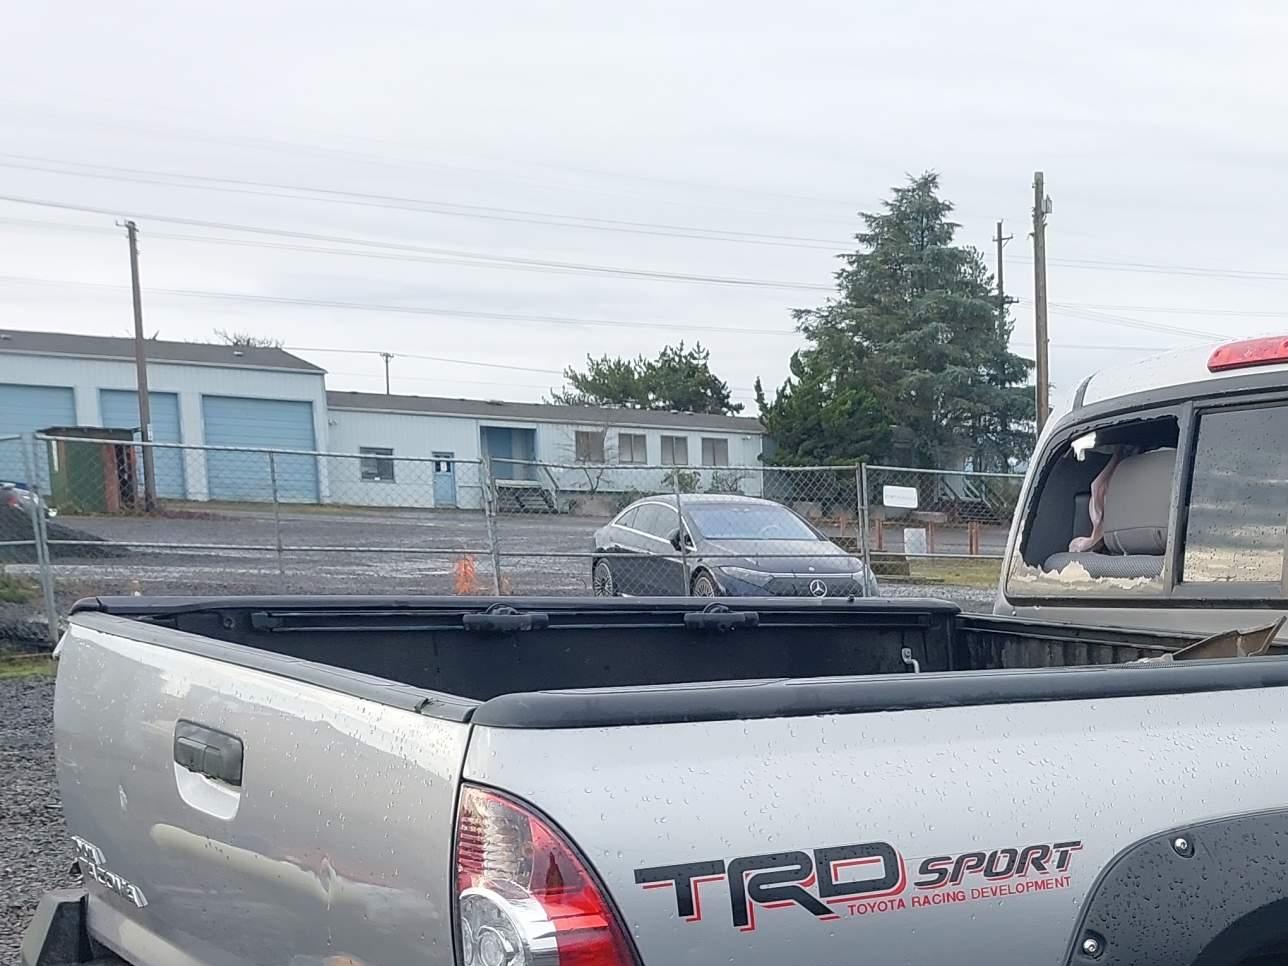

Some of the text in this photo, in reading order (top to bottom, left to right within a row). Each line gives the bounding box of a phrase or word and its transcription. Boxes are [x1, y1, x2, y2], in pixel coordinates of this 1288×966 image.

[633, 840, 1083, 932] TRD SPORT
[847, 876, 1072, 917] TOYOTA RACING DEVELOPMENT
